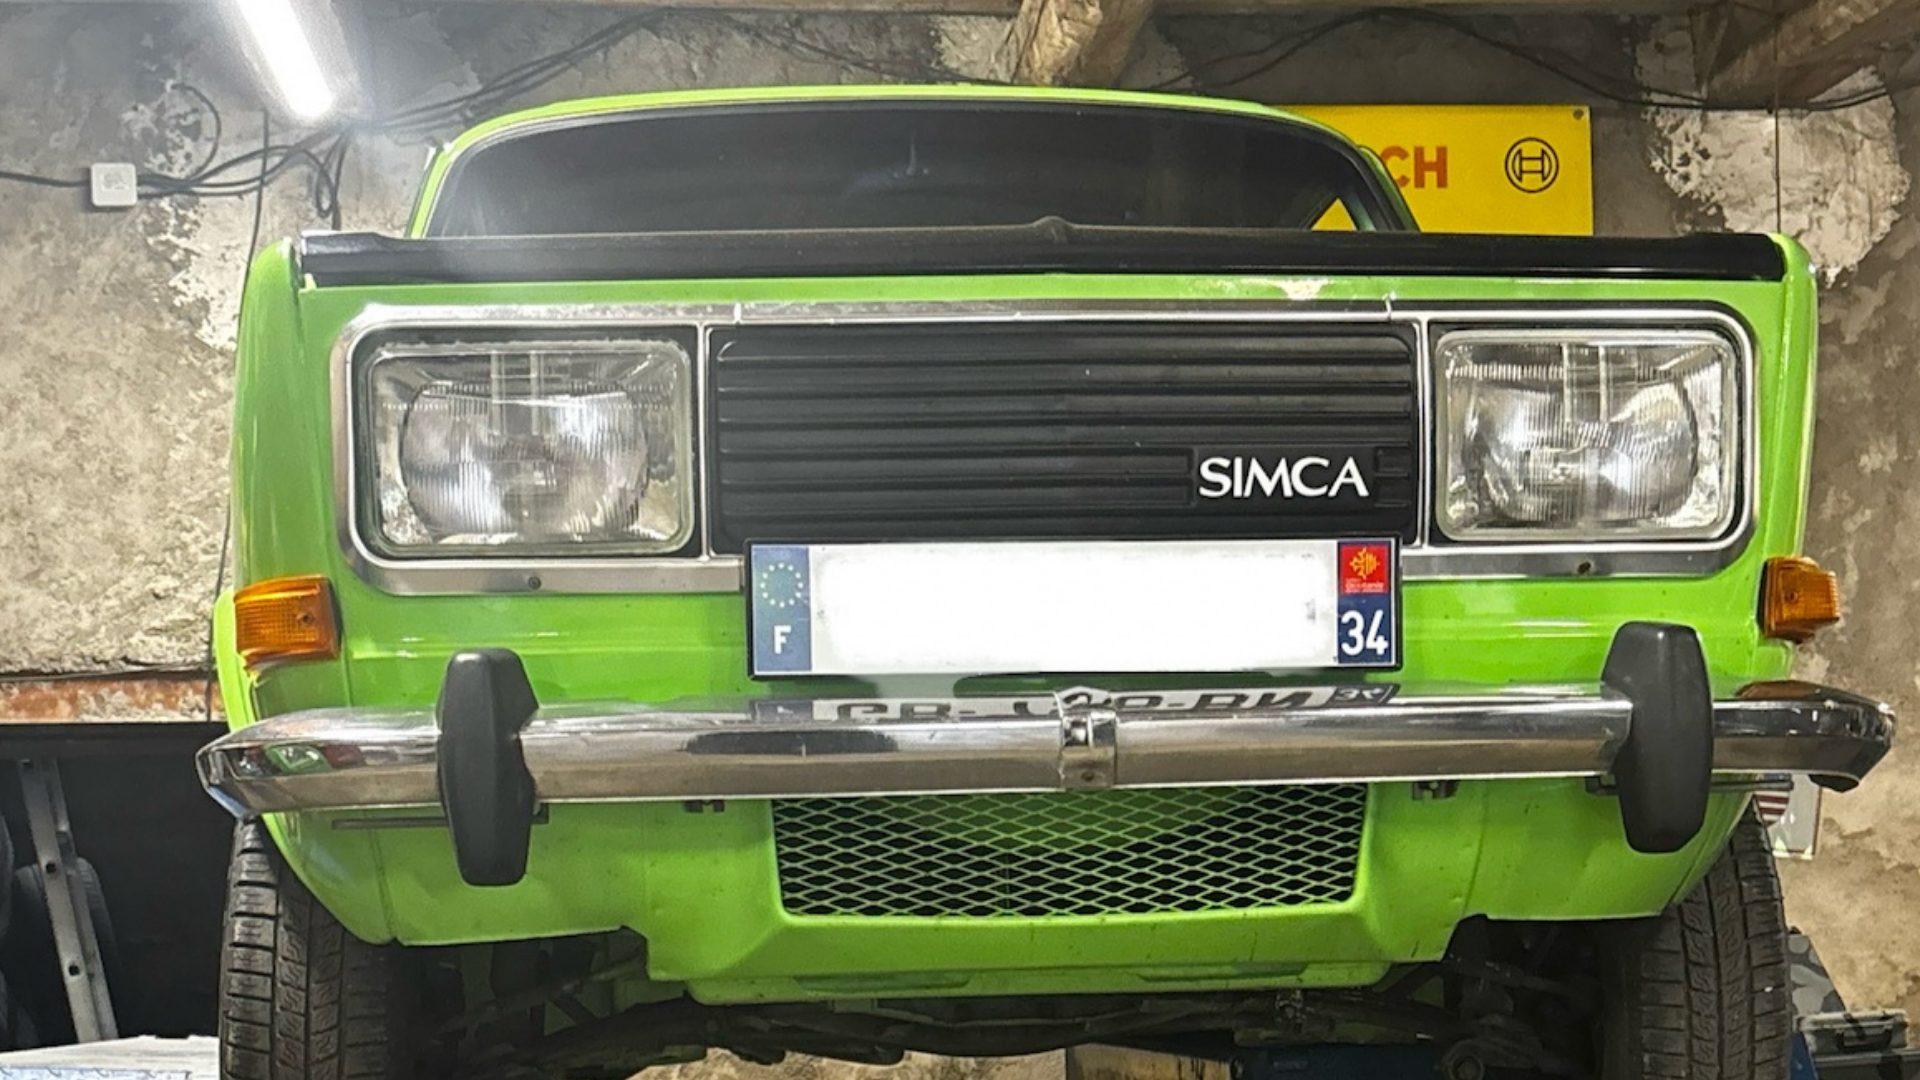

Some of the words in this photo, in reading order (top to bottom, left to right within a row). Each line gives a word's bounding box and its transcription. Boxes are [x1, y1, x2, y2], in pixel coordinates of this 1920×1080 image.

[1199, 456, 1370, 497] SIMCA
[774, 625, 792, 654] F
[1341, 609, 1388, 655] 34
